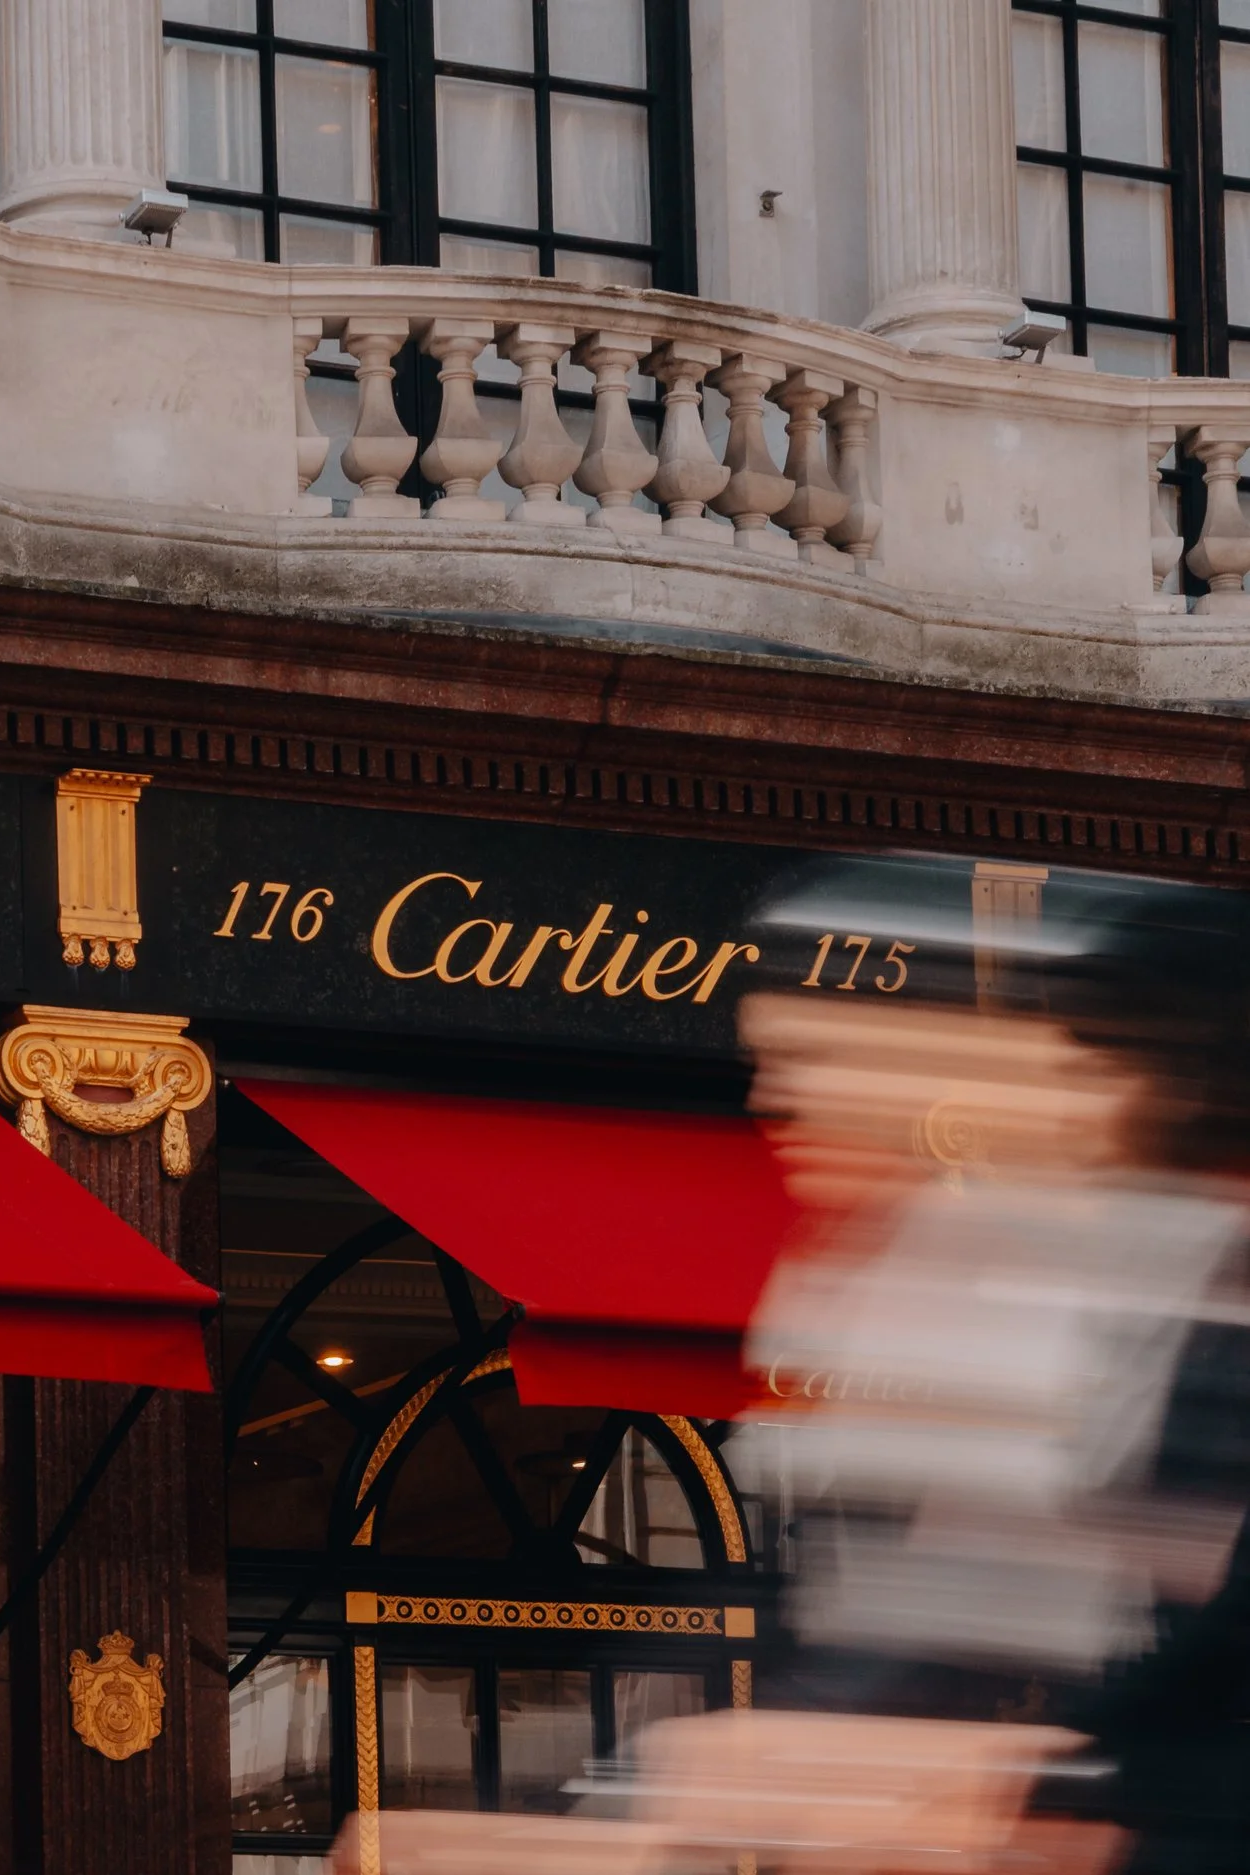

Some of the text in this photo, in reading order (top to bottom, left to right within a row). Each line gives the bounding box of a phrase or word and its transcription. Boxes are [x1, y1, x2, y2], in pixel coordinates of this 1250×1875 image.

[213, 872, 917, 1002] 176 Cartier 175
